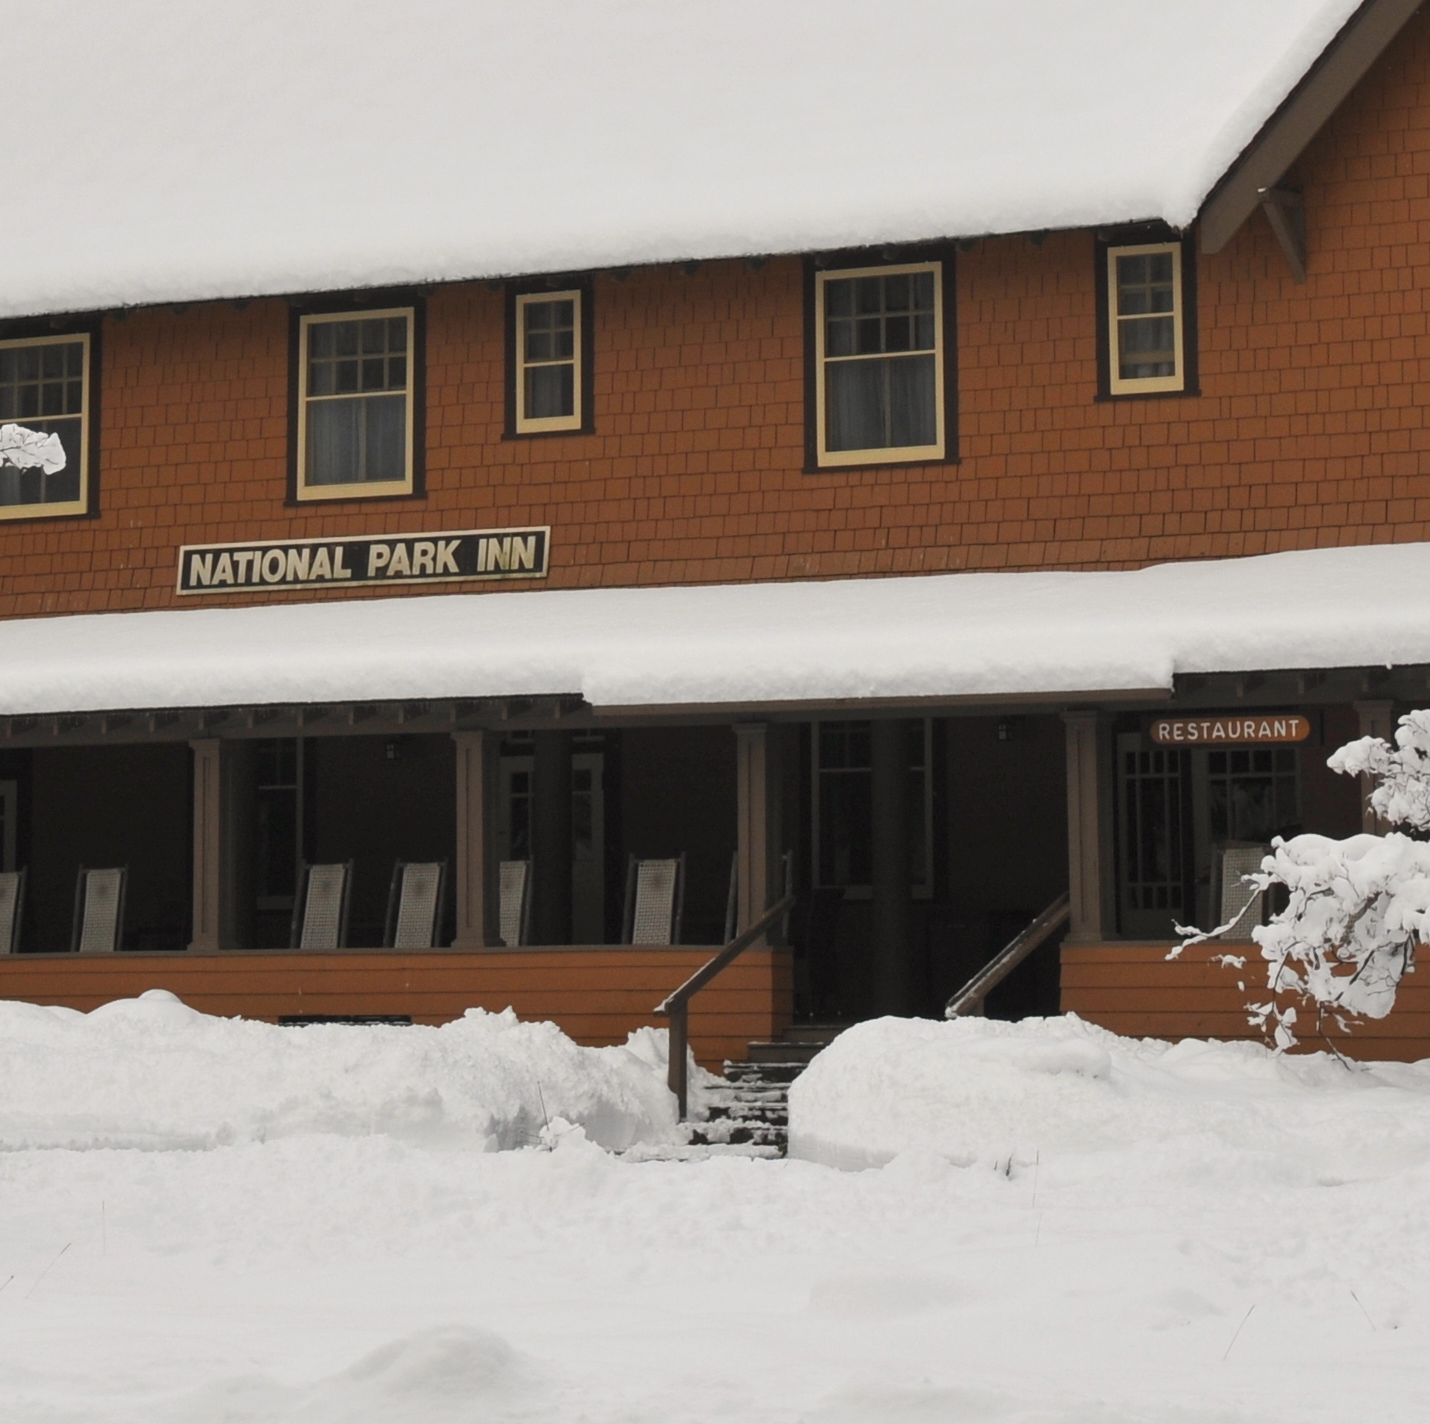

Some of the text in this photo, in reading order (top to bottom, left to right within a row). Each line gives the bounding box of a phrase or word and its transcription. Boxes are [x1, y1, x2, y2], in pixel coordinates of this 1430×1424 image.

[189, 536, 536, 586] NATIONAL PARK INN
[1158, 719, 1300, 741] RESTAURANT
